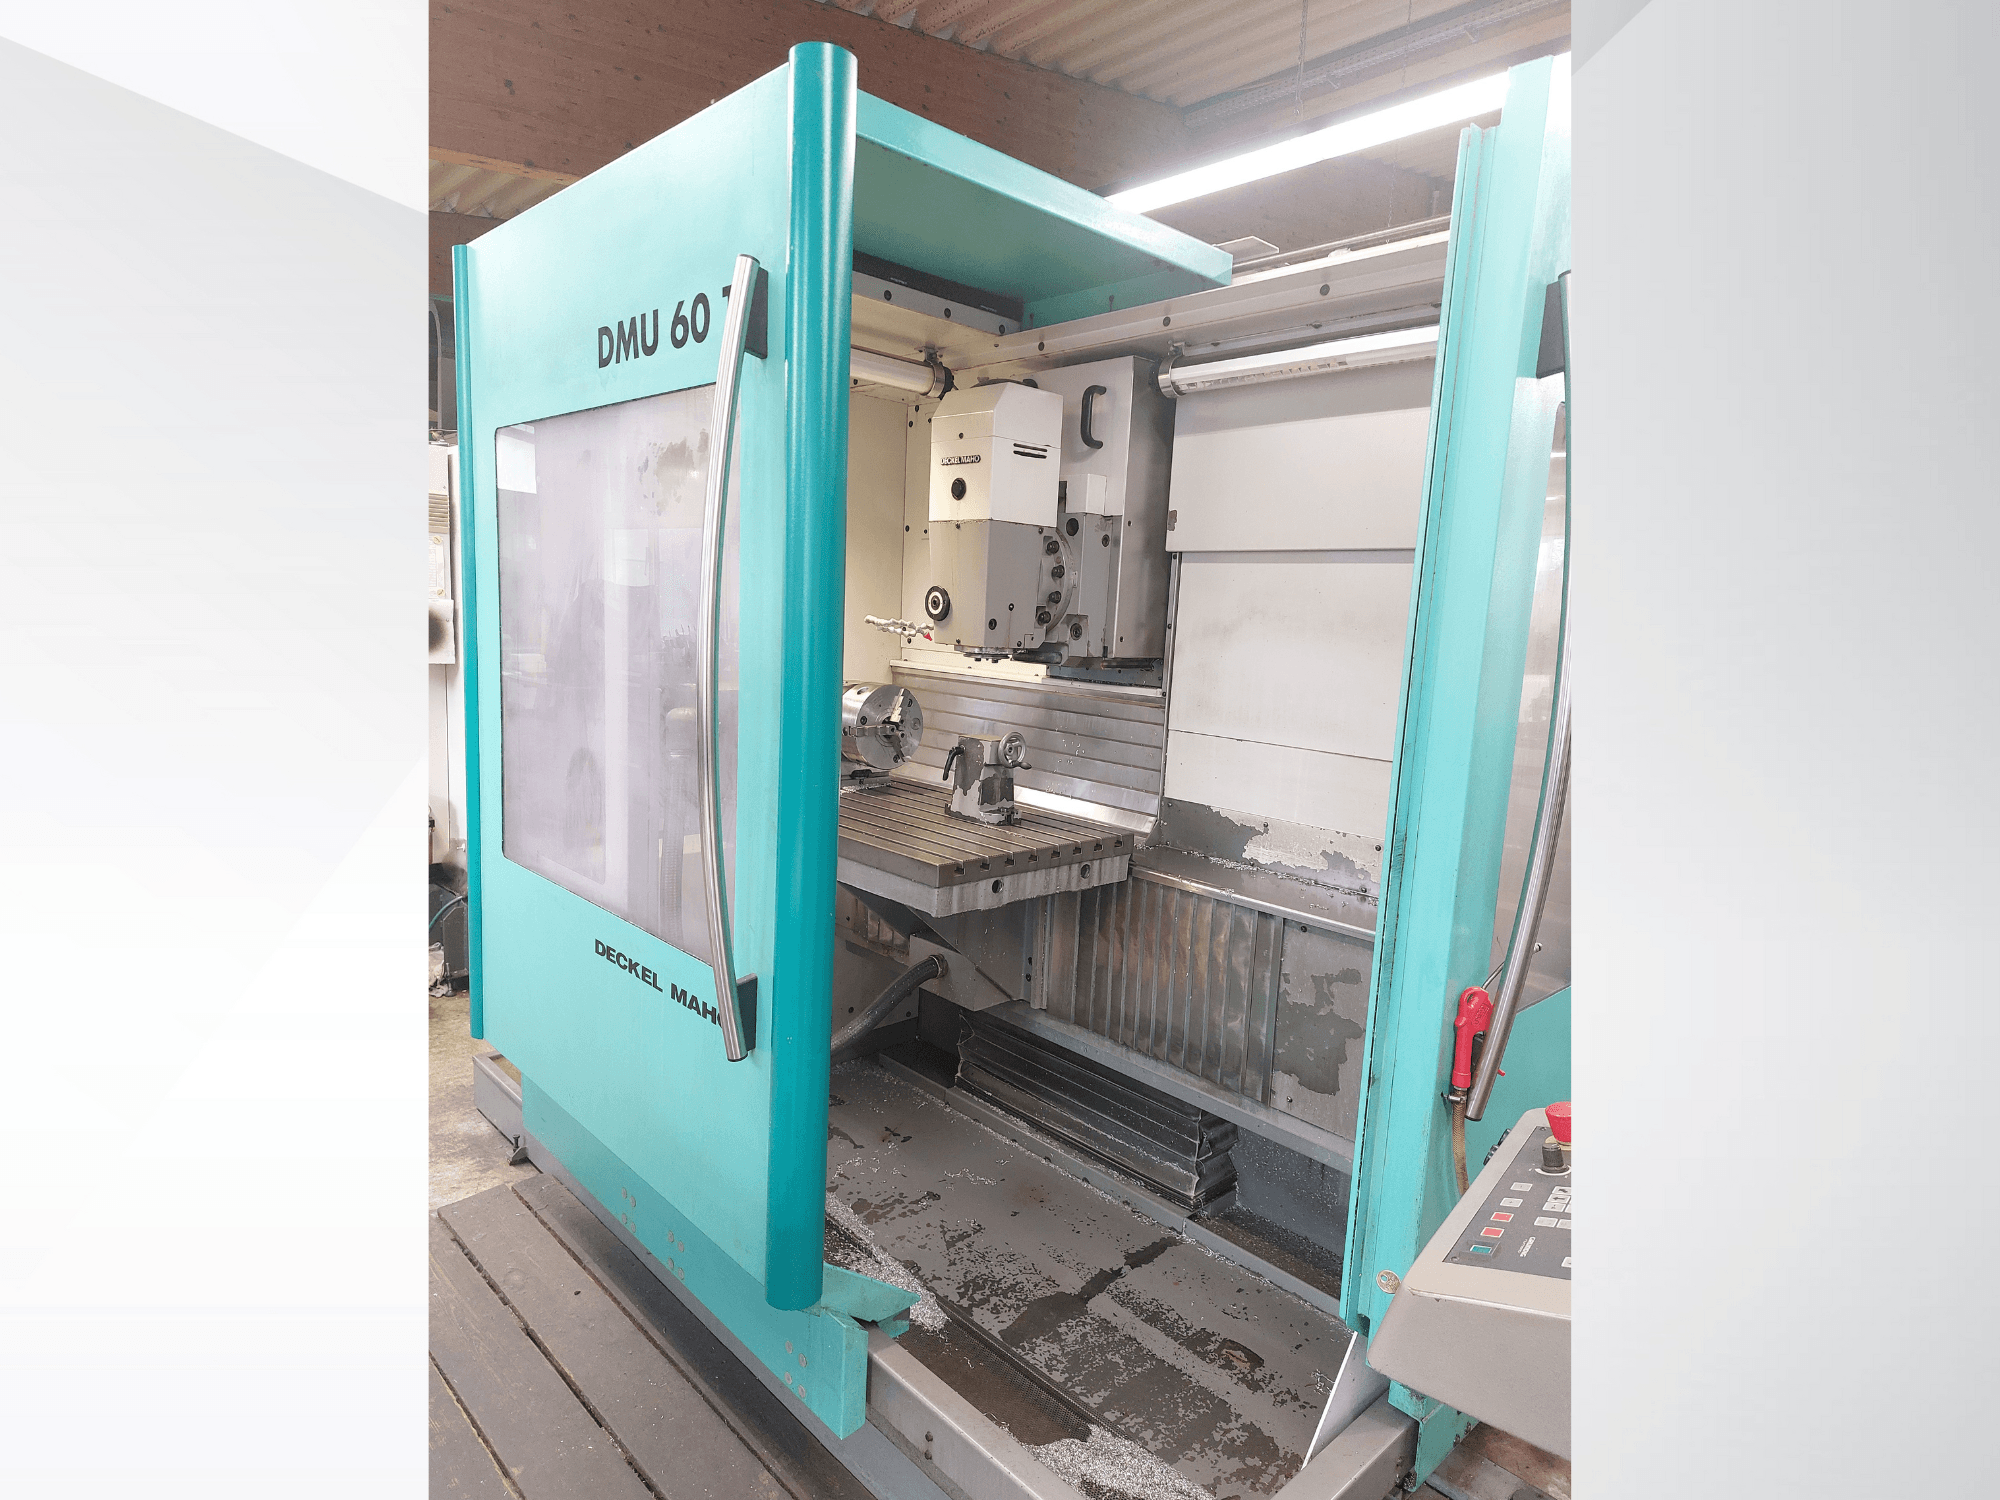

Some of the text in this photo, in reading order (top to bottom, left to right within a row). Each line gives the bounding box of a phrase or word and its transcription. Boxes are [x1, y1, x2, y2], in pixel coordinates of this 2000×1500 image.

[598, 292, 711, 369] DMU 60
[961, 454, 982, 464] MAHO
[594, 938, 723, 1029] DECKEL MAH
